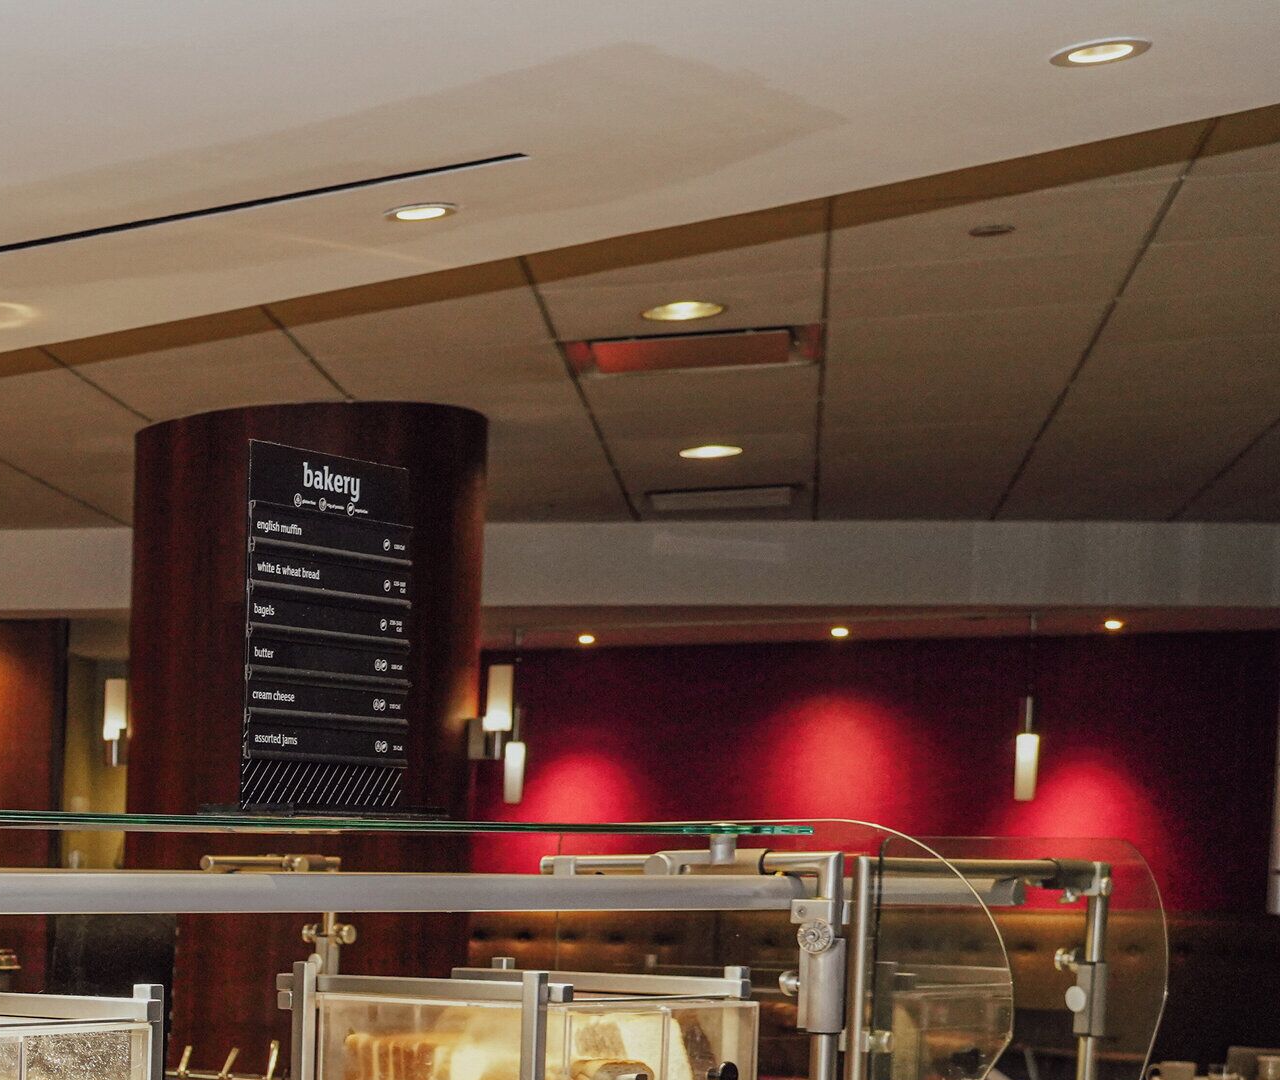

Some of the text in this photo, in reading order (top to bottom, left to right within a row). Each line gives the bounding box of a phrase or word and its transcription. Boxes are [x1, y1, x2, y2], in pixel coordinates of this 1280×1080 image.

[302, 461, 361, 503] bakery
[256, 520, 302, 536] english muffin
[257, 561, 320, 580] white & wheat bread
[253, 602, 275, 617] bagels
[254, 646, 274, 658] butter
[252, 690, 295, 702] cream cheese
[254, 733, 297, 747] assorted jams
